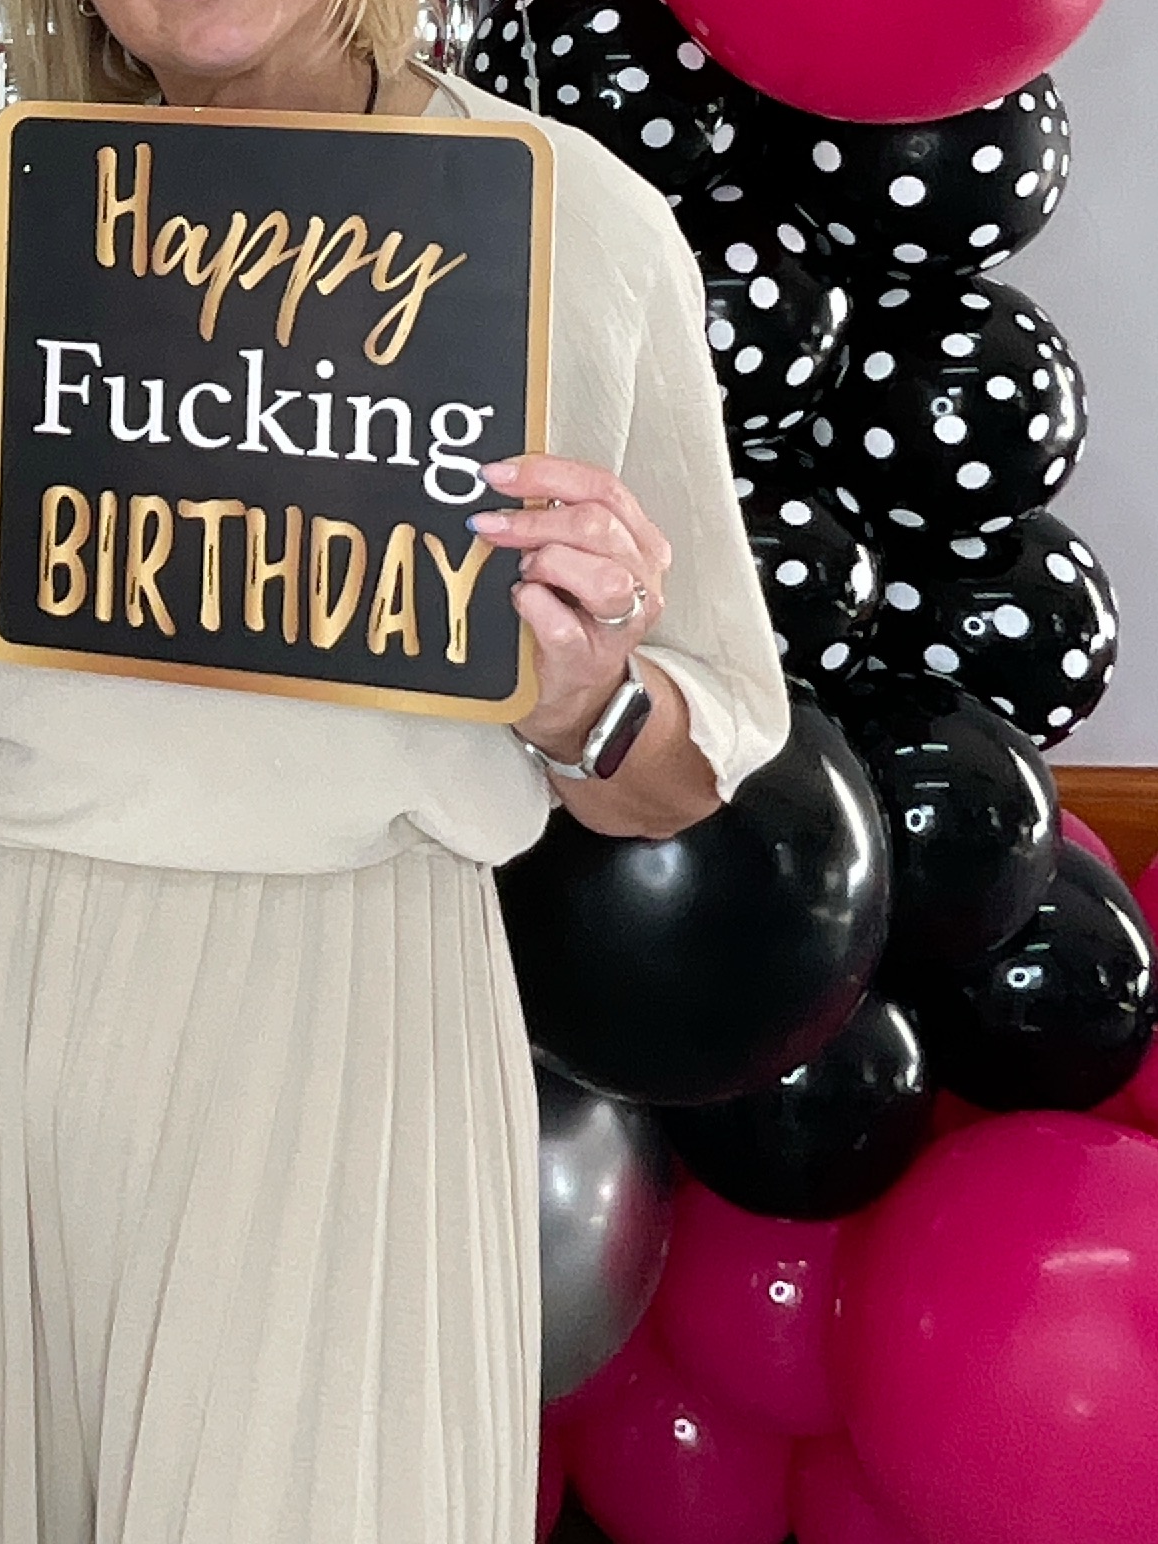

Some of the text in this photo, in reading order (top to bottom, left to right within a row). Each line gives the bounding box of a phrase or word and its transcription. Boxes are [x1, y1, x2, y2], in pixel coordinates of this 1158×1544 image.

[95, 142, 468, 366] Happy
[33, 338, 495, 505] Fucking
[36, 484, 496, 664] BIRTHDAY
